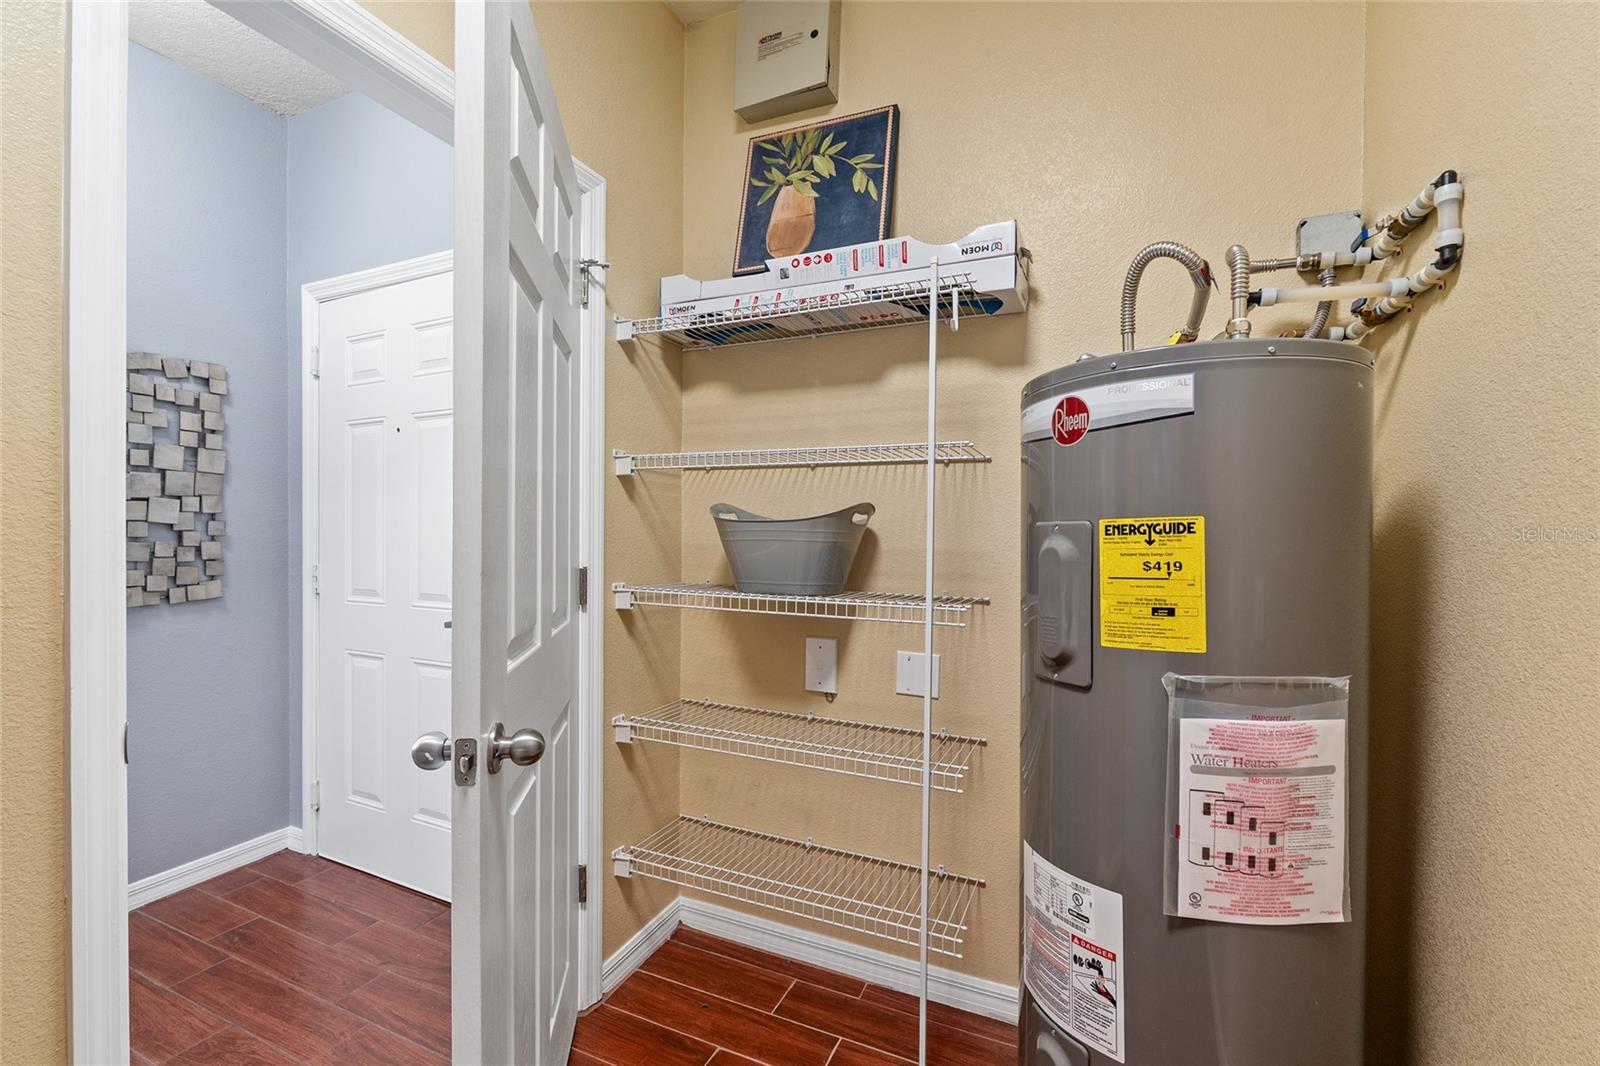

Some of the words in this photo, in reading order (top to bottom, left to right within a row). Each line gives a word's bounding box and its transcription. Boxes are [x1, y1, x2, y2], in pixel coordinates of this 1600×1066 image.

[961, 244, 989, 255] MOEN
[676, 304, 696, 314] MOEN
[1107, 376, 1190, 395] PROESSIOAL
[1054, 399, 1088, 439] Rheem
[1104, 522, 1196, 538] ENERGYGUIDE
[1142, 560, 1183, 572] $419
[1251, 714, 1291, 722] IMPORTANT
[1191, 753, 1229, 767] Water
[1233, 756, 1279, 769] Heaters
[1248, 777, 1287, 785] IMPORTANT
[1080, 940, 1114, 960] DANGER
